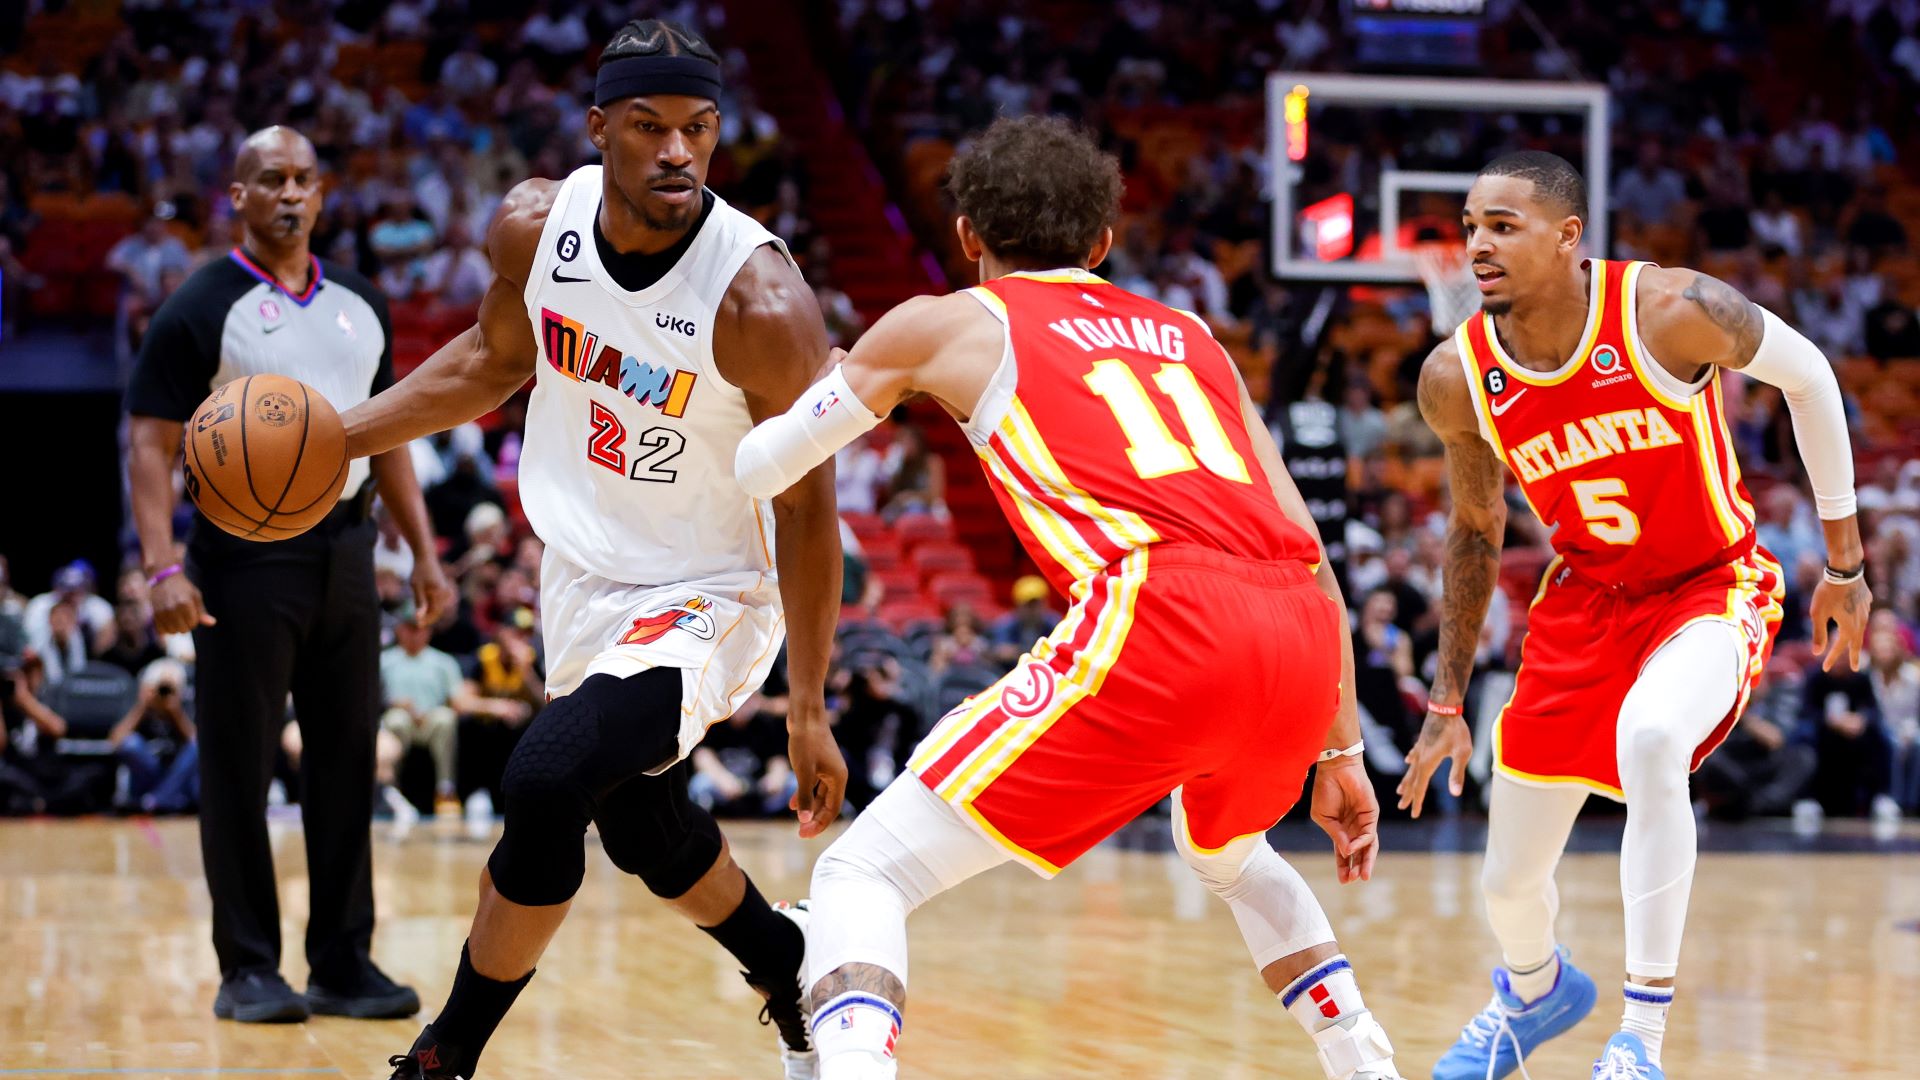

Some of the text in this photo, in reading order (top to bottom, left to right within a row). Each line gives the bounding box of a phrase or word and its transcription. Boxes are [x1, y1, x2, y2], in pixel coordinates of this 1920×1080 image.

[561, 235, 577, 259] 6
[1048, 317, 1185, 361] YOUNG
[1488, 370, 1504, 393] 6
[1591, 371, 1633, 388] sharecare
[1082, 358, 1253, 484] 11
[1509, 407, 1683, 484] ATLANTA
[1570, 478, 1641, 545] 5
